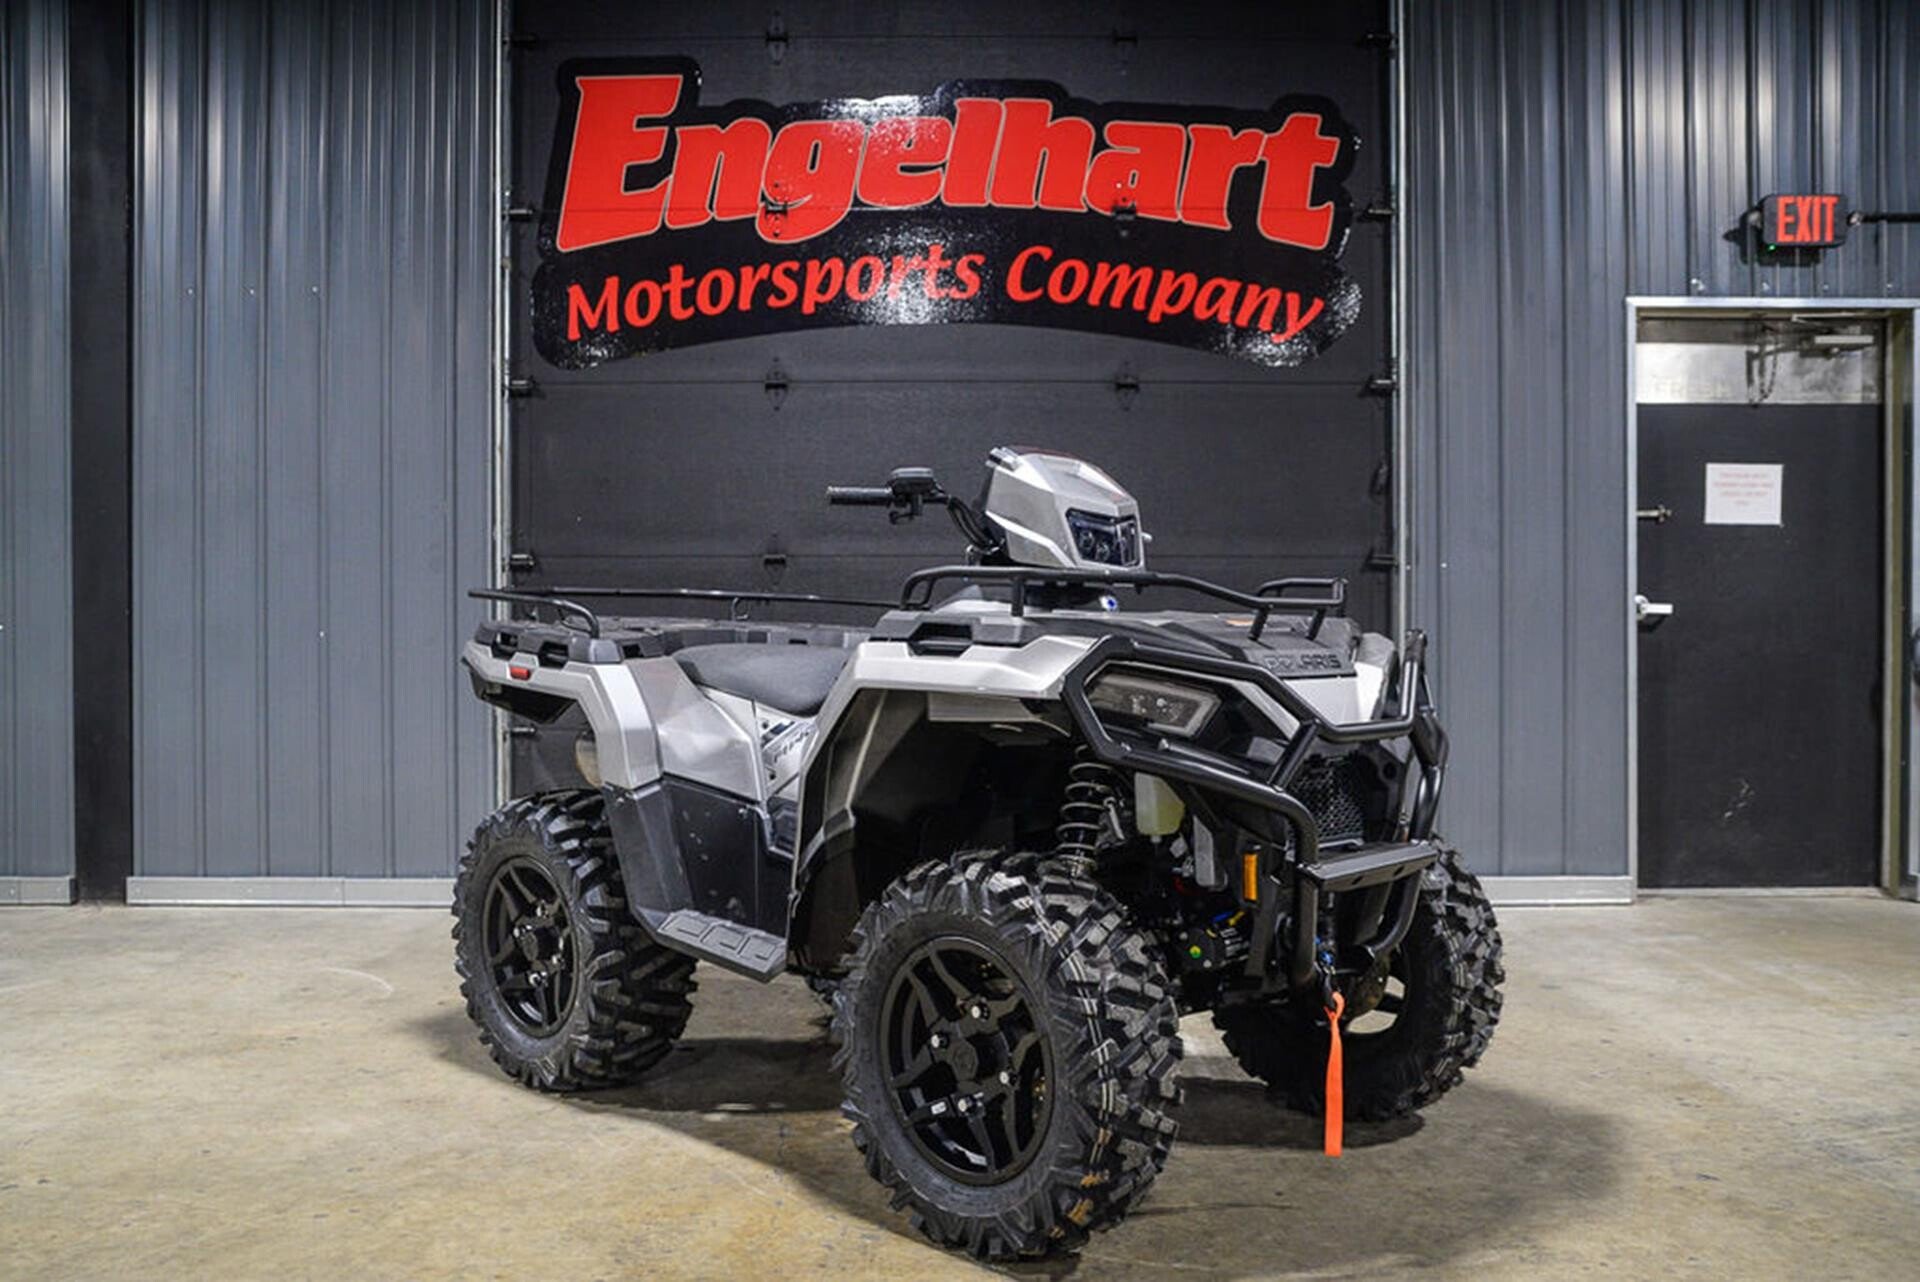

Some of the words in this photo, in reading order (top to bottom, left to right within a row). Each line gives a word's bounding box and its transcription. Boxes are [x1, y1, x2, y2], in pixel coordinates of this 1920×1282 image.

[557, 75, 1340, 252] Engelhart
[1777, 196, 1838, 243] EXIT
[567, 243, 983, 341] Motorsports
[1006, 245, 1325, 343] Company
